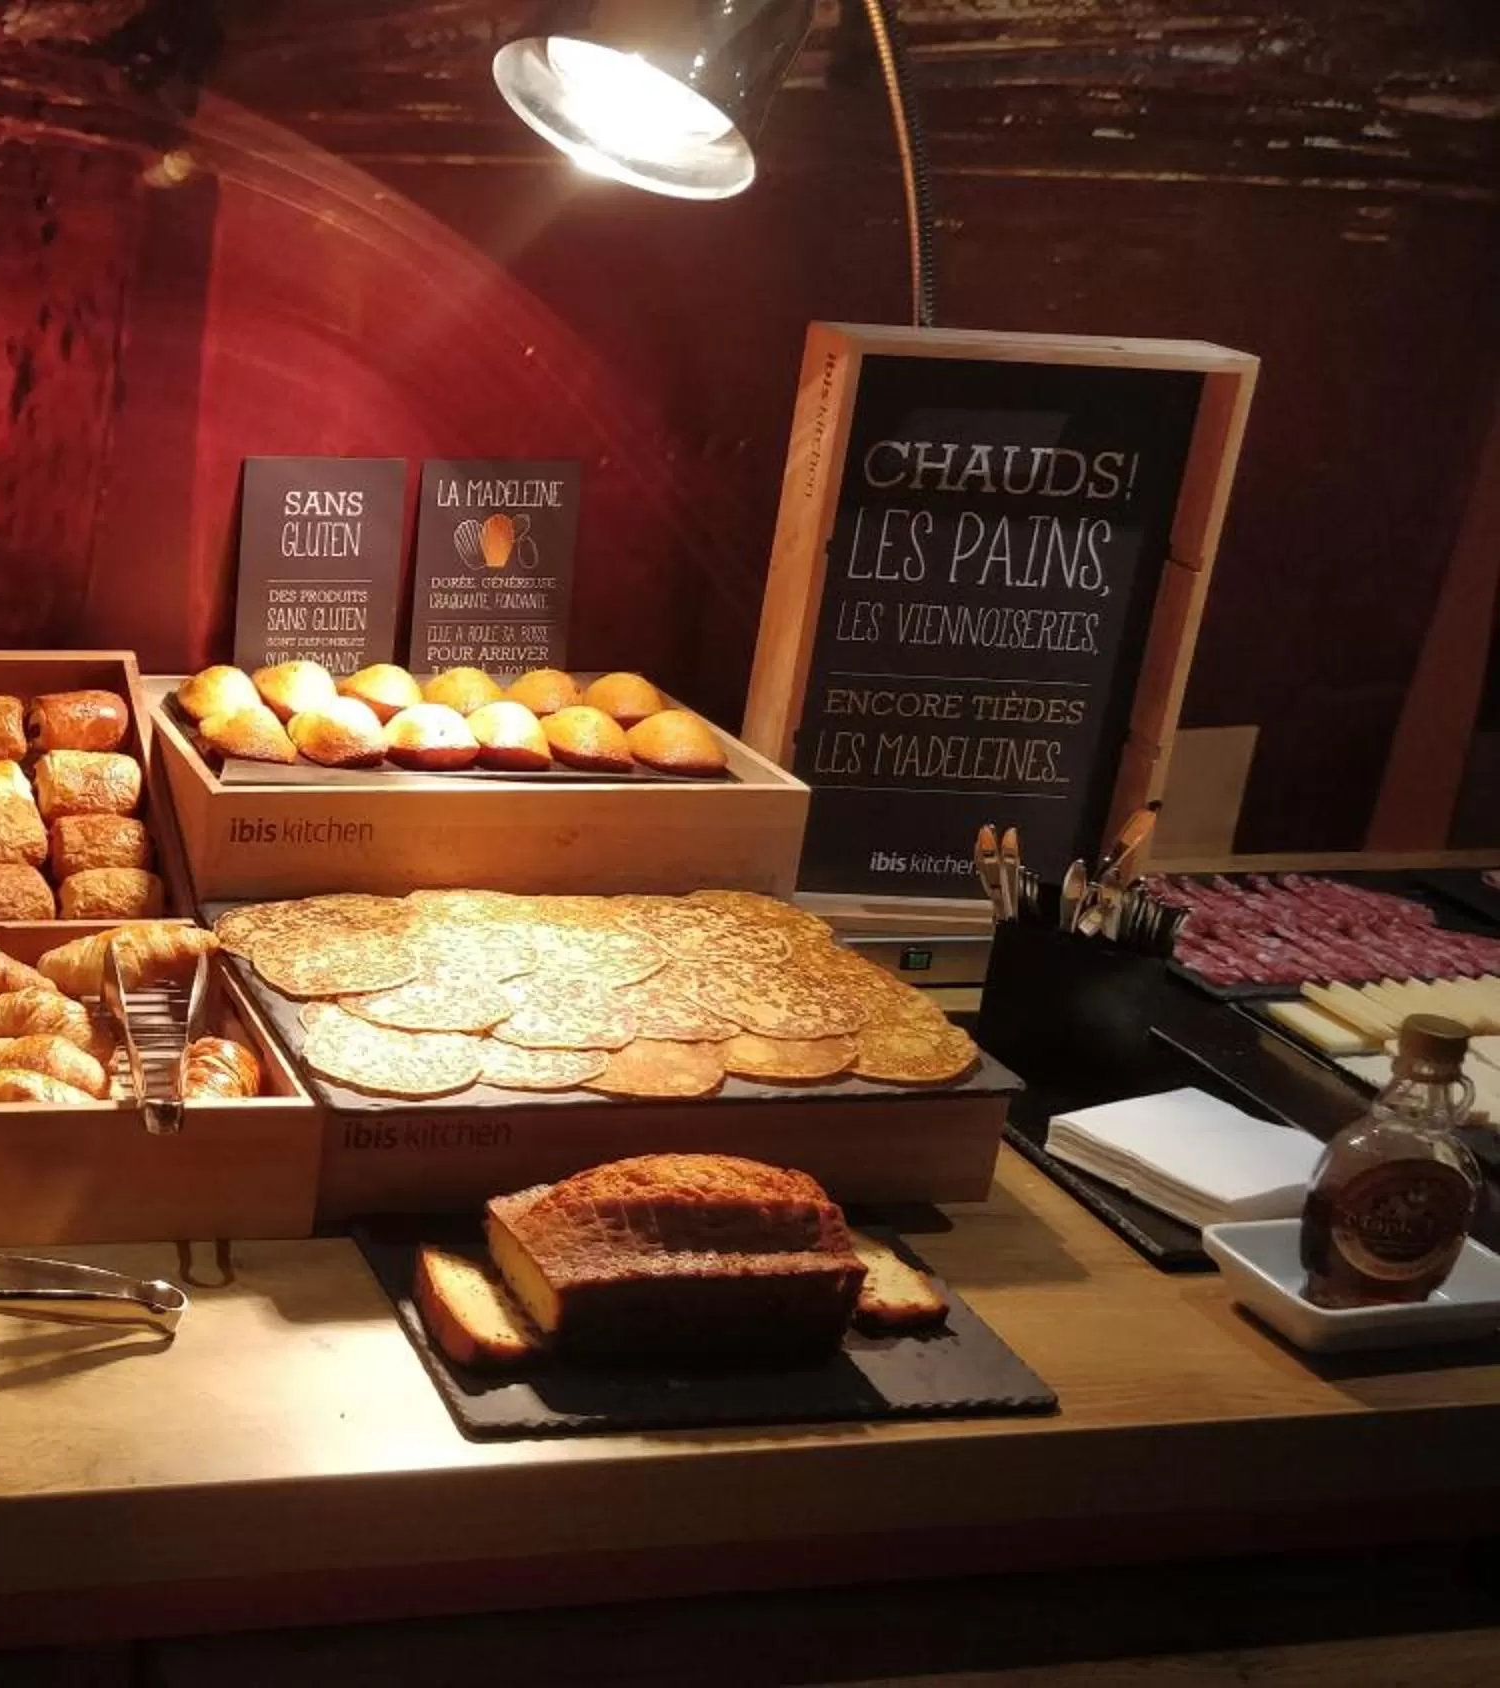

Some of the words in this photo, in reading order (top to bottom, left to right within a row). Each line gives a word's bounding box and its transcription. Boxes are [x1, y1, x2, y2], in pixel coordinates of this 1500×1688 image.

[864, 440, 1140, 501] CHAUDS!
[283, 490, 364, 516] SANS
[437, 479, 460, 507] LA
[466, 479, 565, 507] MADELEINE
[281, 521, 362, 557] GLUTEN
[847, 506, 934, 583] LES
[948, 511, 1112, 597] PAINS,
[268, 589, 297, 603] DES
[299, 589, 369, 603] PRODUITS
[266, 607, 307, 631] SANS
[311, 607, 368, 631] GLUTEN
[836, 600, 885, 641] LES
[897, 602, 1100, 656] VIENNOISERIES,
[427, 625, 453, 643] ELLE
[427, 646, 473, 661] POUR
[477, 646, 549, 661] ARRIVER
[823, 688, 964, 719] ENCORE
[971, 690, 1086, 724] TIÈDES
[814, 729, 866, 775] LES
[229, 816, 277, 844] ibis
[281, 816, 374, 844] kitchen
[868, 851, 907, 872] ibis
[343, 1120, 398, 1150] ibis
[402, 1118, 513, 1148] kitchen
